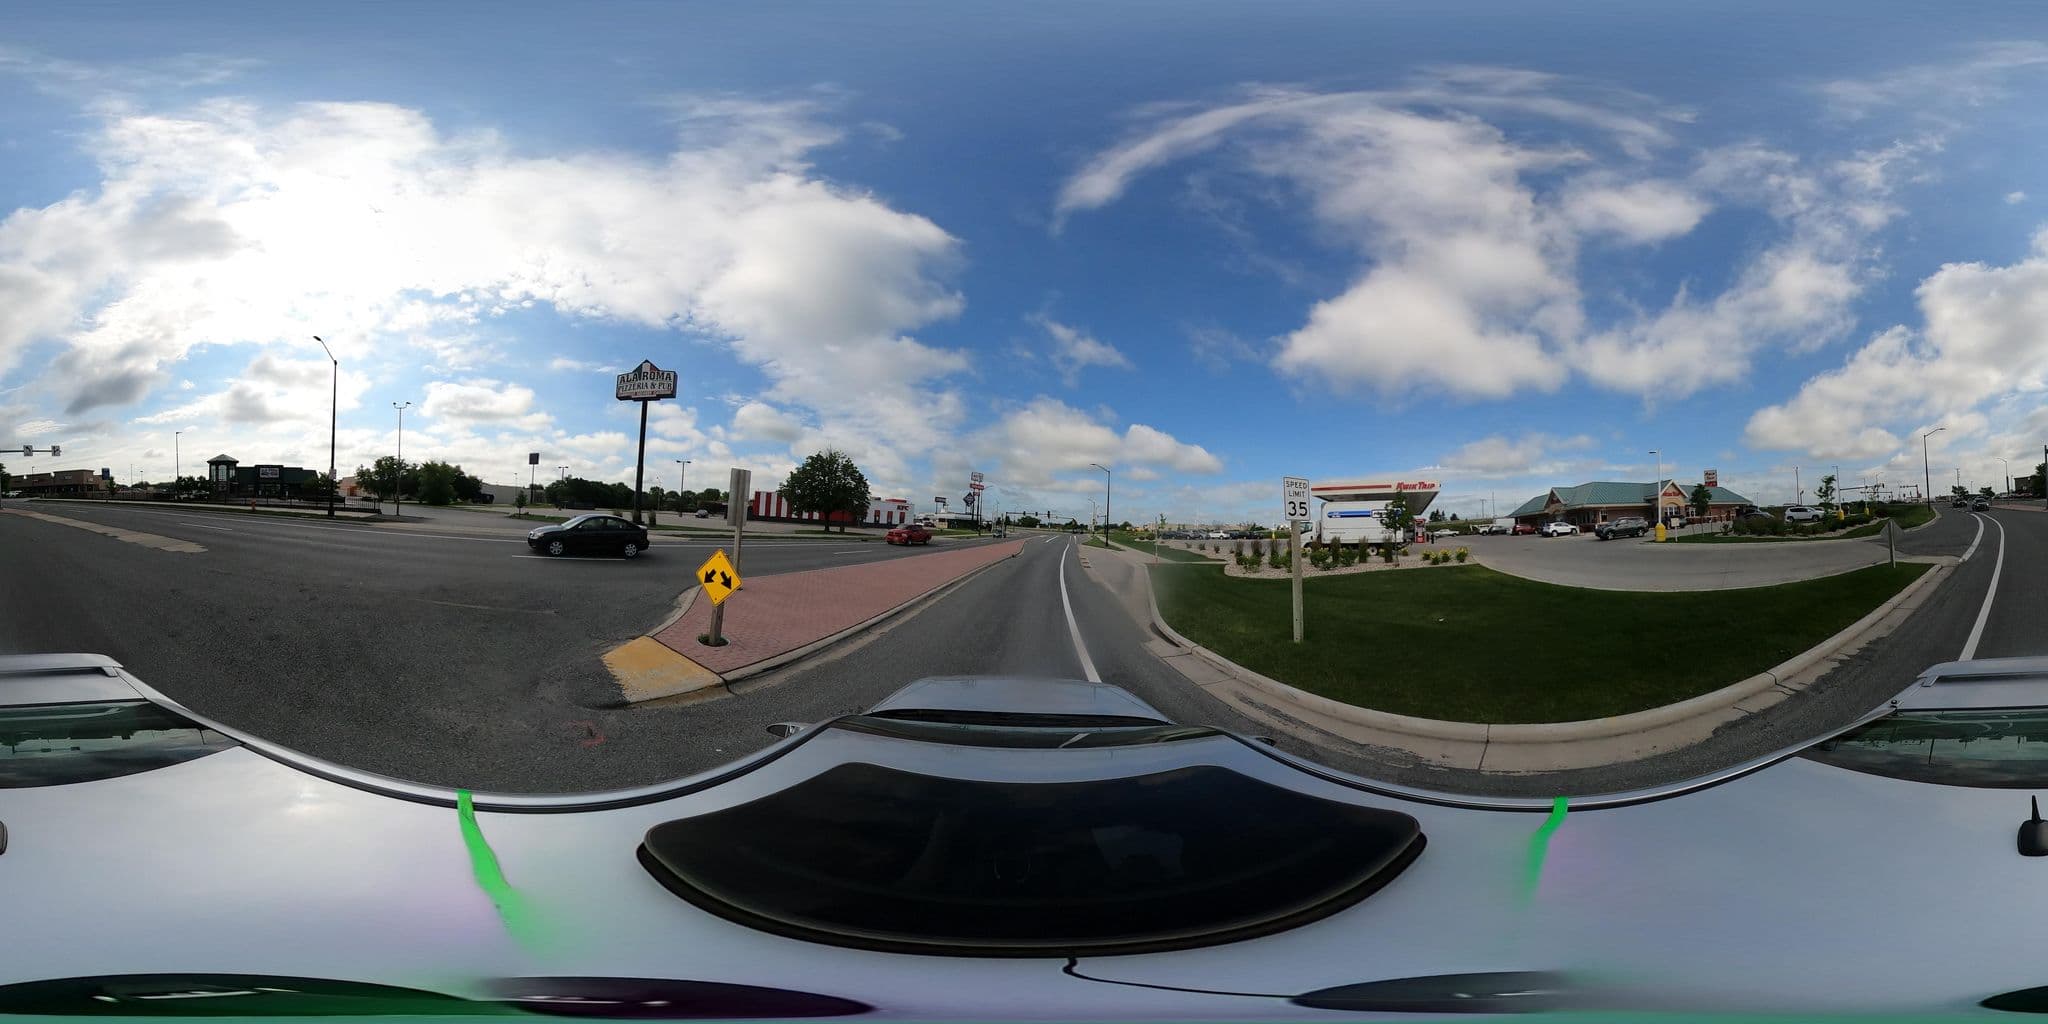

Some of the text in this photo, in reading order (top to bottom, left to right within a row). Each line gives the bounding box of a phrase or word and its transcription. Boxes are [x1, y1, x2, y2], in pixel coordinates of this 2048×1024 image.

[642, 371, 672, 381] ROMA
[618, 382, 648, 392] PIZZERIA
[658, 382, 672, 391] PUB
[1285, 480, 1308, 489] SPEED
[1288, 490, 1306, 498] LIMIT
[1288, 501, 1308, 516] 35
